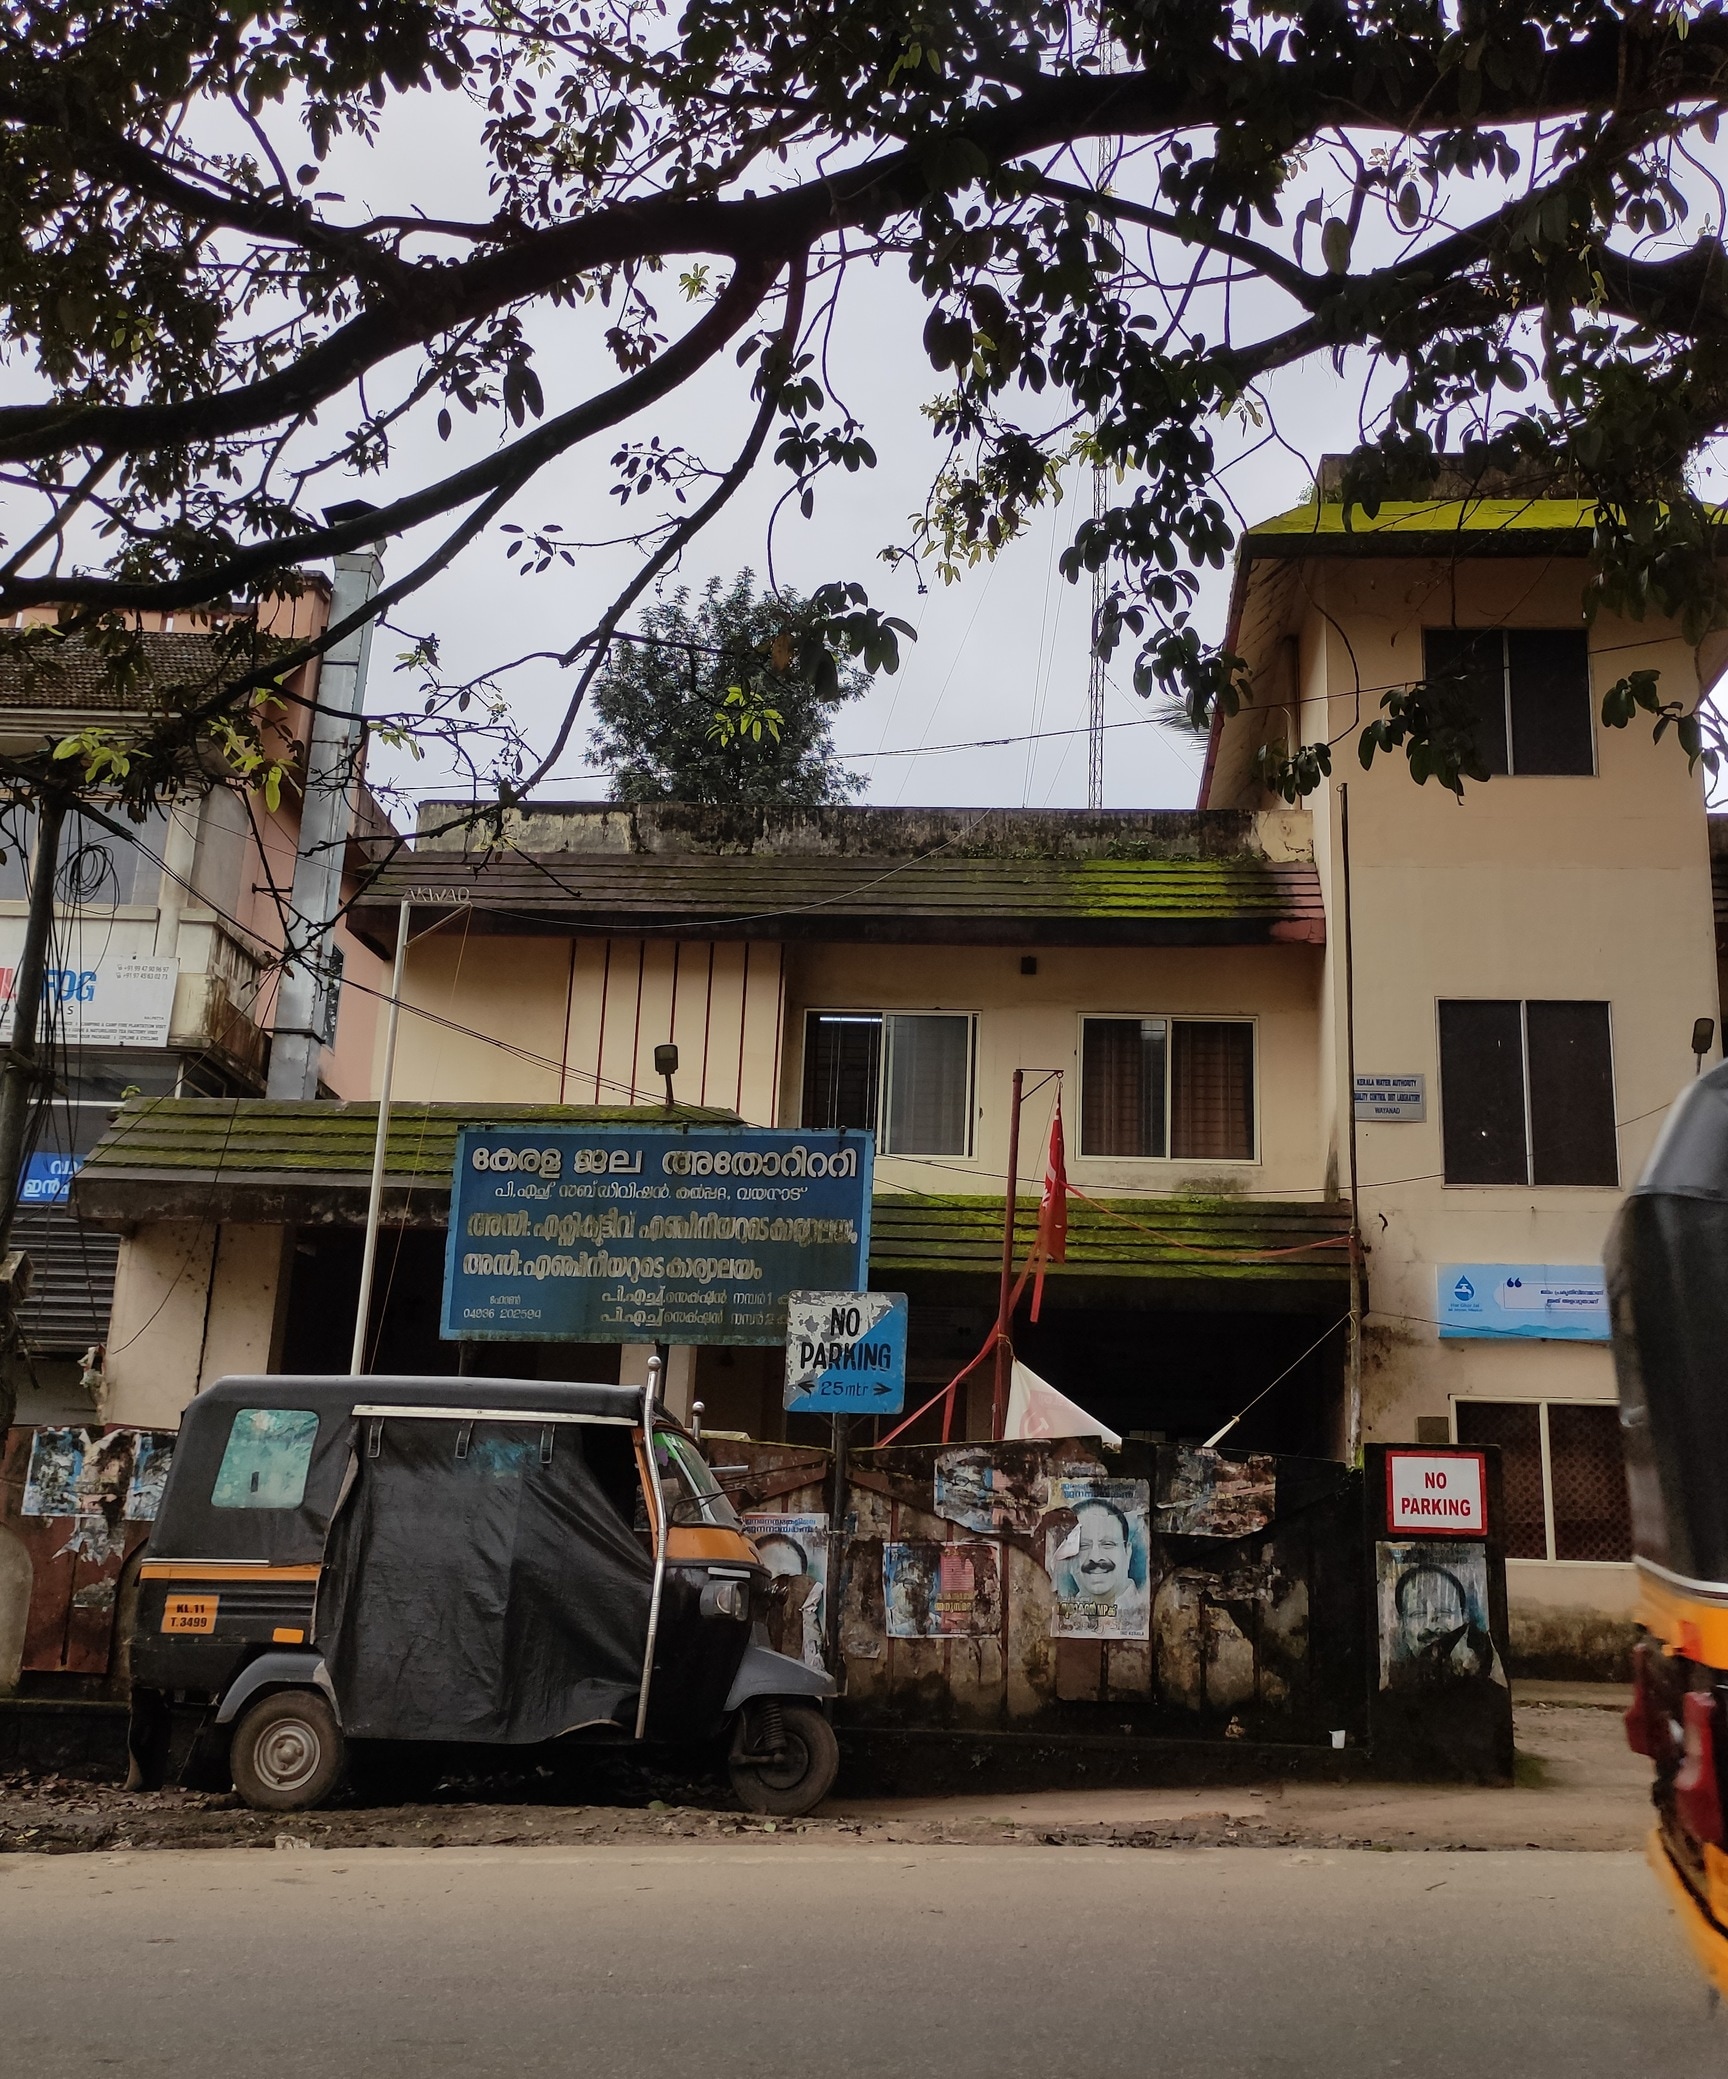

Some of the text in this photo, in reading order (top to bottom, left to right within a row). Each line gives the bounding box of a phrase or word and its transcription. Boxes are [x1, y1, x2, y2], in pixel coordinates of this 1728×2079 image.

[472, 1147, 563, 1179] കേരള
[573, 1149, 643, 1174] ജല
[463, 1308, 541, 1320] 04936 202594
[830, 1307, 860, 1337] NO
[800, 1341, 891, 1371] PARKING
[1425, 1472, 1447, 1489] NO
[1401, 1497, 1471, 1516] PARKING
[170, 1616, 208, 1627] T.3499
